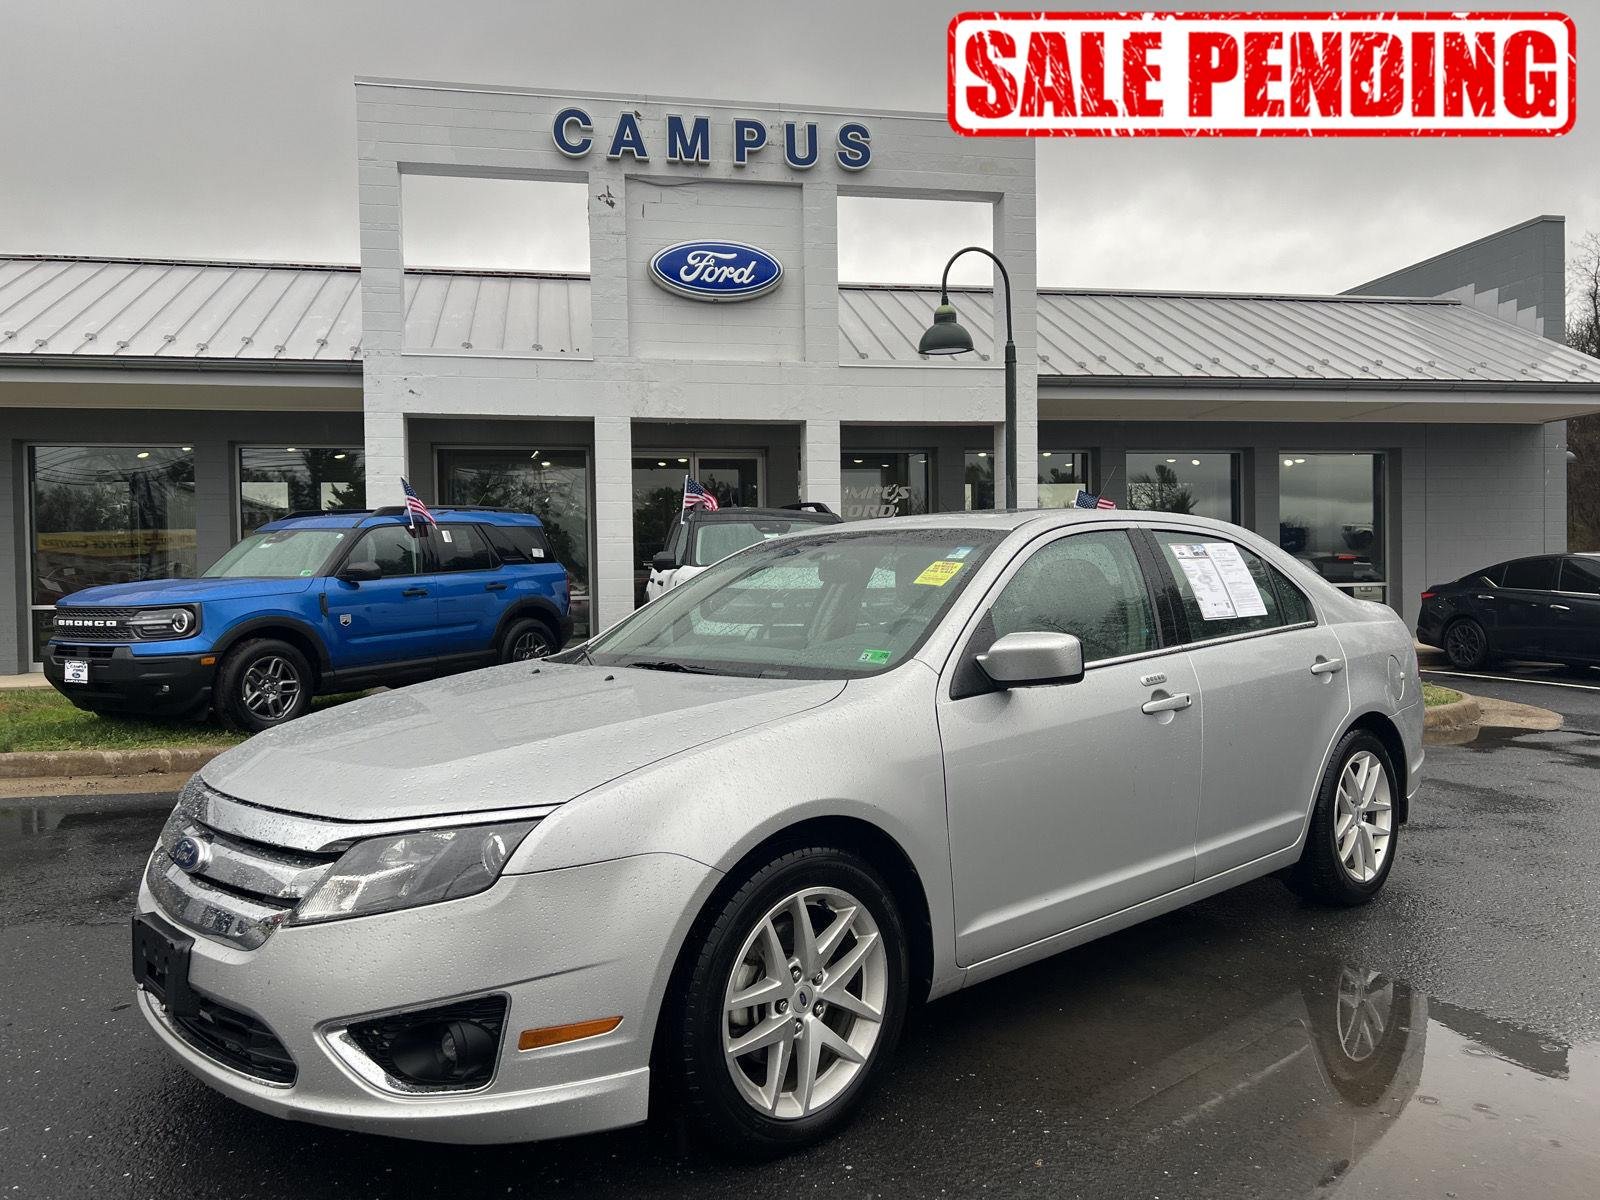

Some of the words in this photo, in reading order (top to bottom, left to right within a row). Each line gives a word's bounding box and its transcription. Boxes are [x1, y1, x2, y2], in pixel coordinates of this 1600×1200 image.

[552, 106, 873, 172] CAMPUS
[679, 250, 757, 284] Ford
[58, 619, 117, 627] BRONCO
